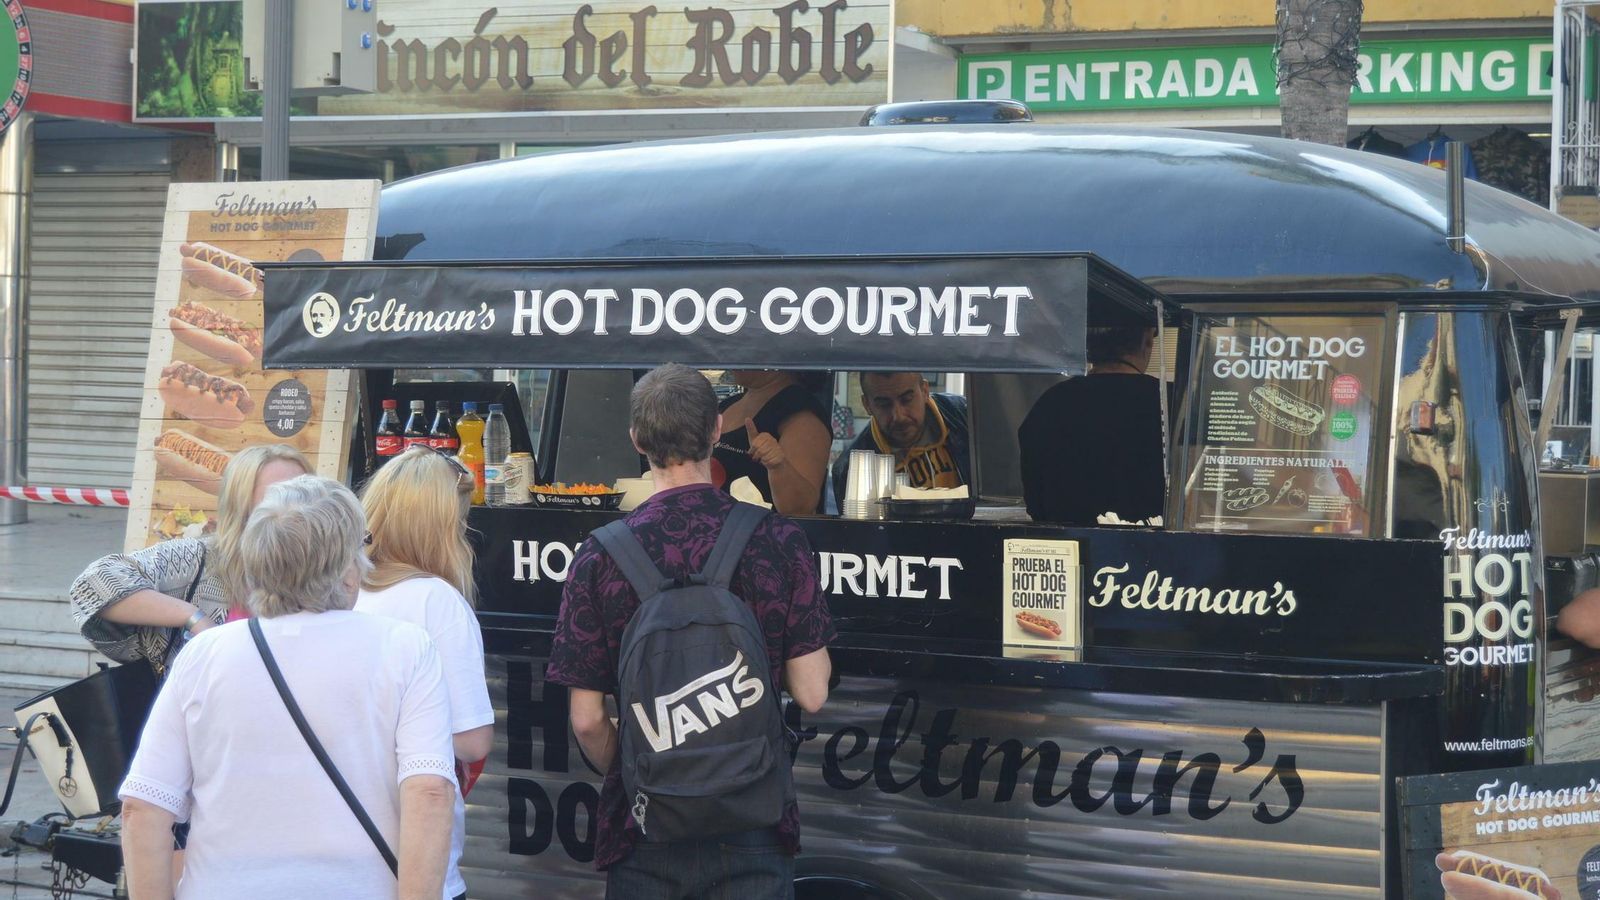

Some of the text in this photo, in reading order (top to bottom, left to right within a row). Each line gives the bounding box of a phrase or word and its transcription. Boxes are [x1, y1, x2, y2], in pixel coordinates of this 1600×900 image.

[377, 0, 875, 93] incón del Roble
[1025, 57, 1259, 102] ENTRADA
[211, 191, 318, 217] Feltman's
[210, 222, 232, 233] HOT
[234, 222, 259, 232] DOG
[343, 286, 1034, 337] Feltman's HOT DOG GOURMET
[1215, 336, 1366, 358] EL HOT DOG
[1212, 359, 1330, 381] GOURMET
[277, 418, 294, 430] 4,00
[1205, 455, 1285, 467] INGREDIENTES
[545, 495, 580, 505] Feltman's
[1439, 525, 1531, 551] Feltman's
[512, 539, 583, 584] HO
[1012, 557, 1067, 574] PRUEBA EL
[1012, 573, 1067, 592] HOT DOG
[1443, 552, 1532, 599] HOT
[1012, 591, 1067, 610] GOURMET
[1088, 562, 1297, 617] Feltman's
[1443, 599, 1533, 643] DOG
[1443, 643, 1535, 666] GOURMET
[631, 650, 765, 752] VANS
[1444, 735, 1535, 752] www.feltmans.es
[507, 777, 600, 863] DO
[1475, 810, 1600, 836] HOT DOG GOURME
